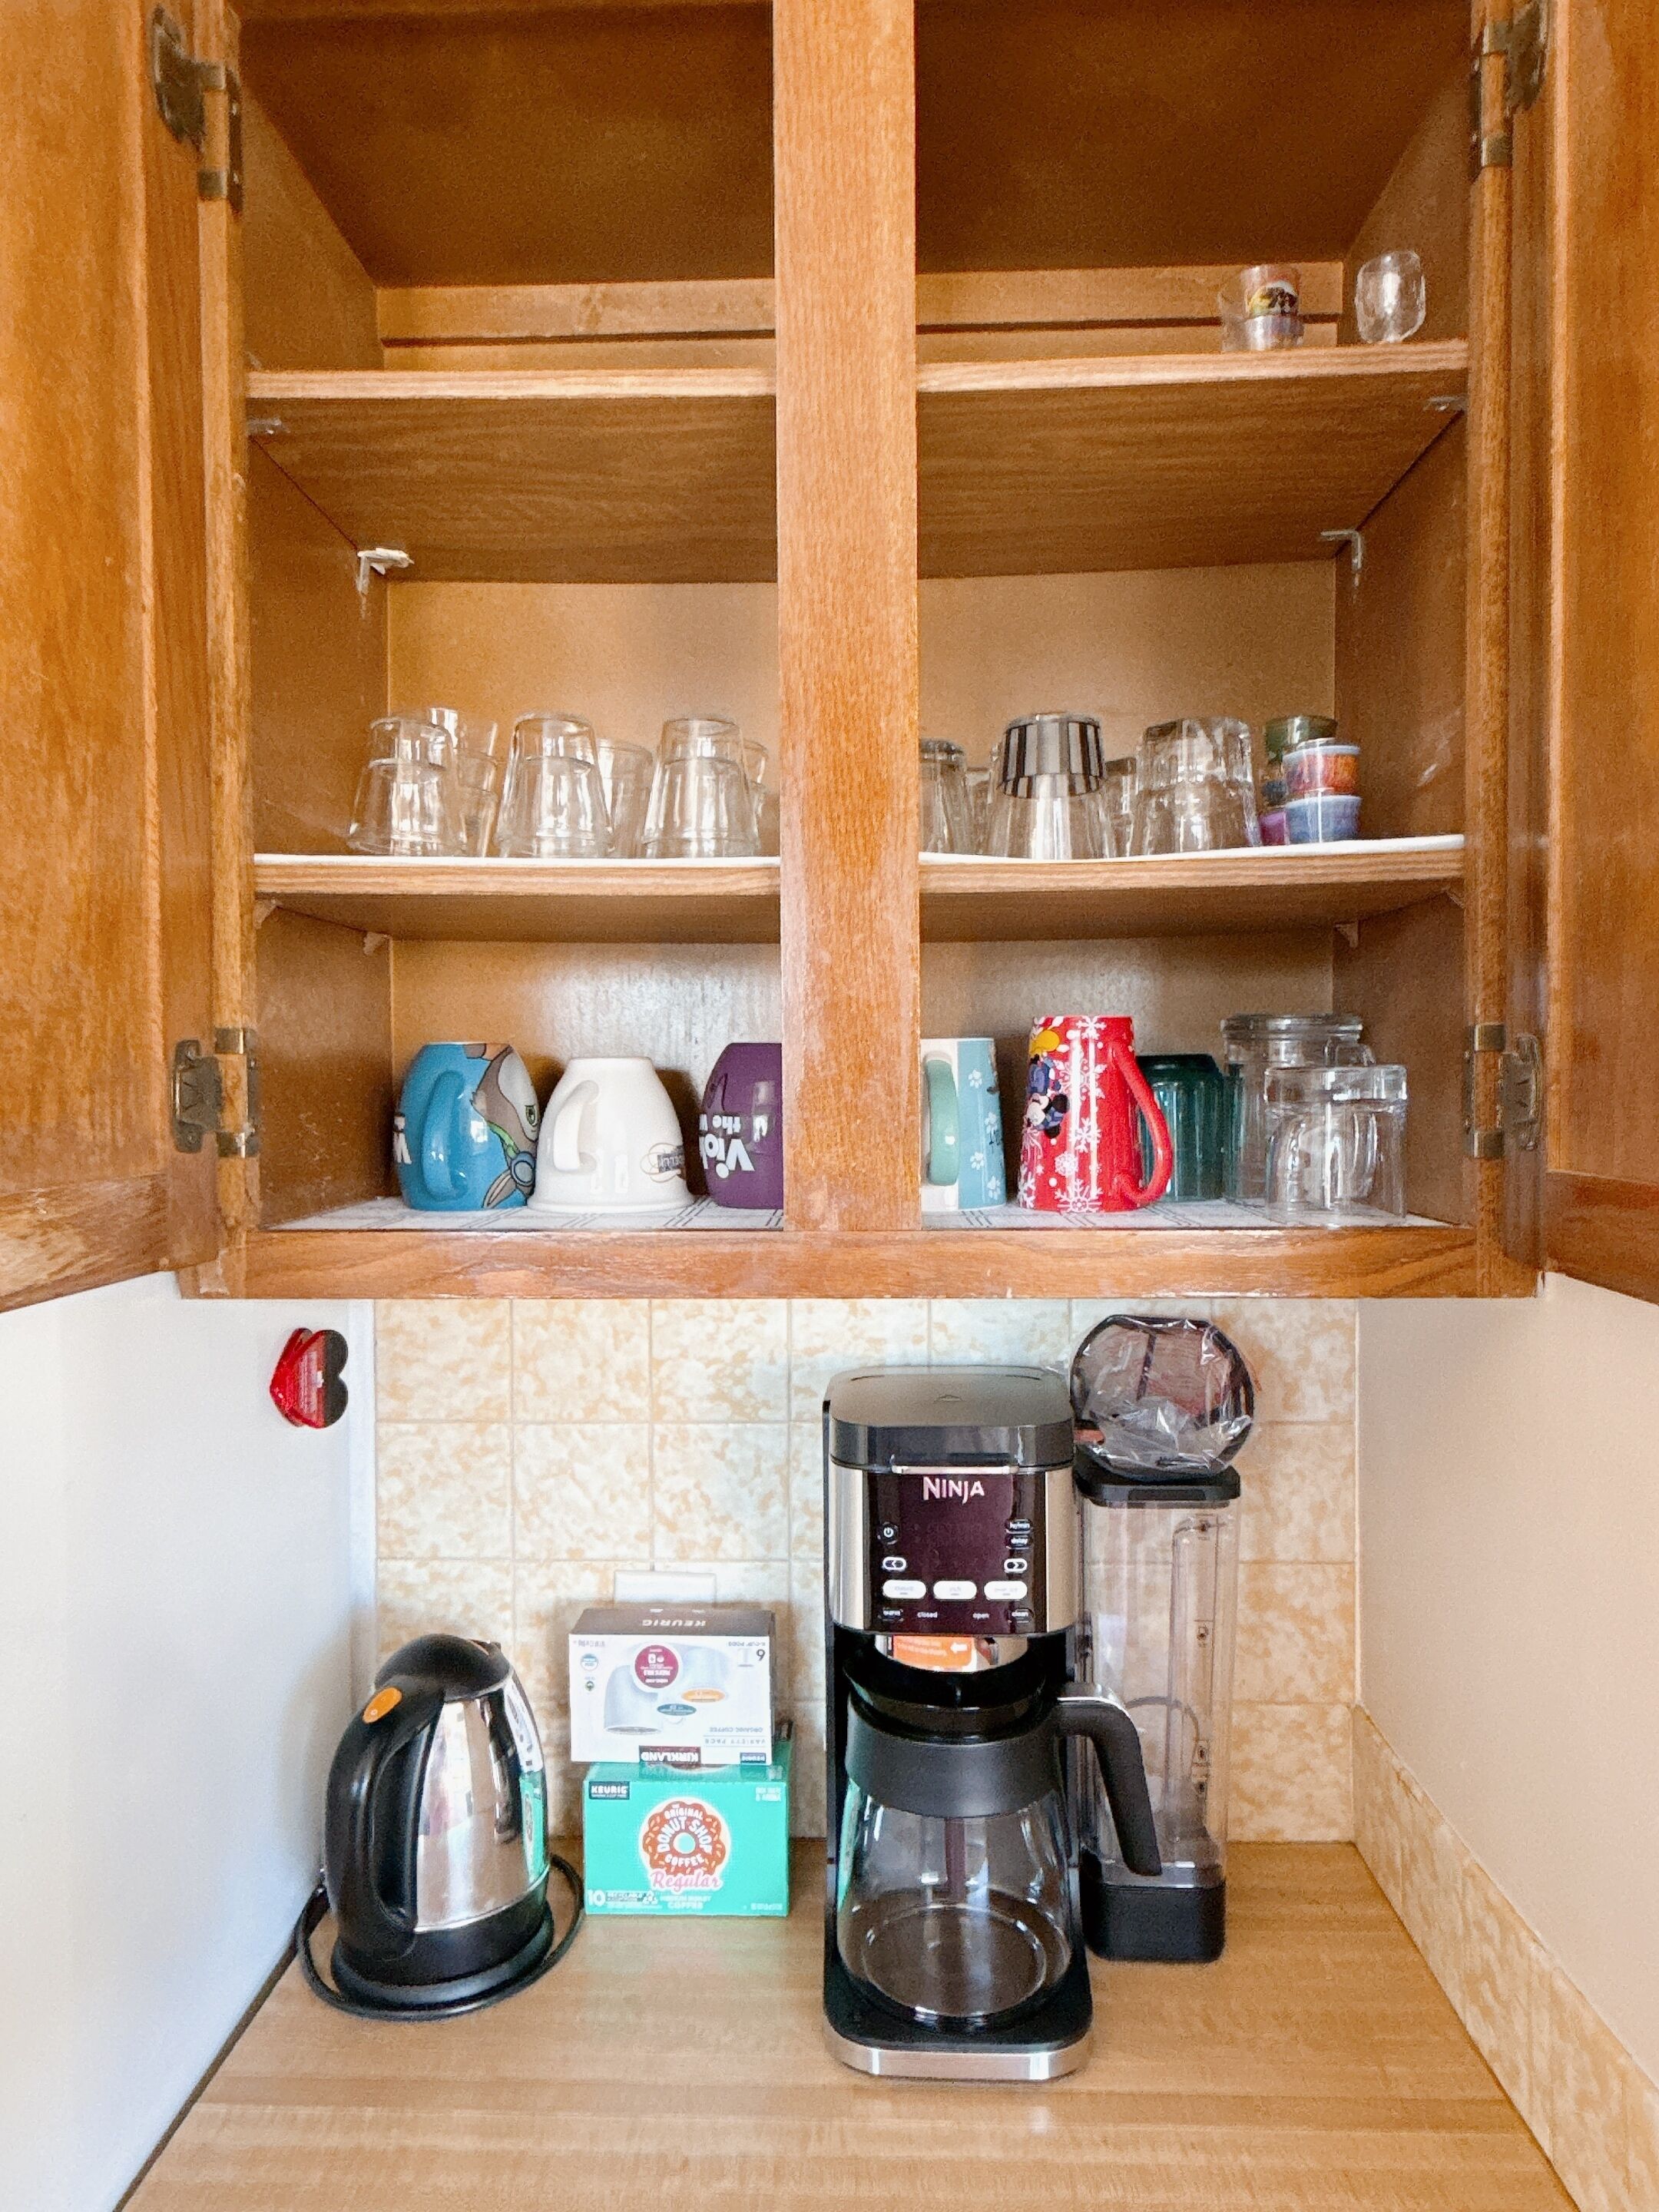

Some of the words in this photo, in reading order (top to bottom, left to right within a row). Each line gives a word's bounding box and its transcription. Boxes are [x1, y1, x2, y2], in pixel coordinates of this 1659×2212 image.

[713, 1115, 740, 1134] the
[923, 1476, 985, 1505] NINJA
[756, 1648, 767, 1661] 6
[641, 1751, 699, 1762] KIRKLAND
[591, 1786, 628, 1794] KEURIG
[664, 1807, 704, 1820] ORIGINAL
[657, 1816, 687, 1853] DONUT
[688, 1819, 713, 1855] SHOP
[664, 1853, 705, 1868] COFFEE
[651, 1870, 720, 1892] Regular
[588, 1889, 606, 1906] 10
[667, 1902, 704, 1910] COFFEE
